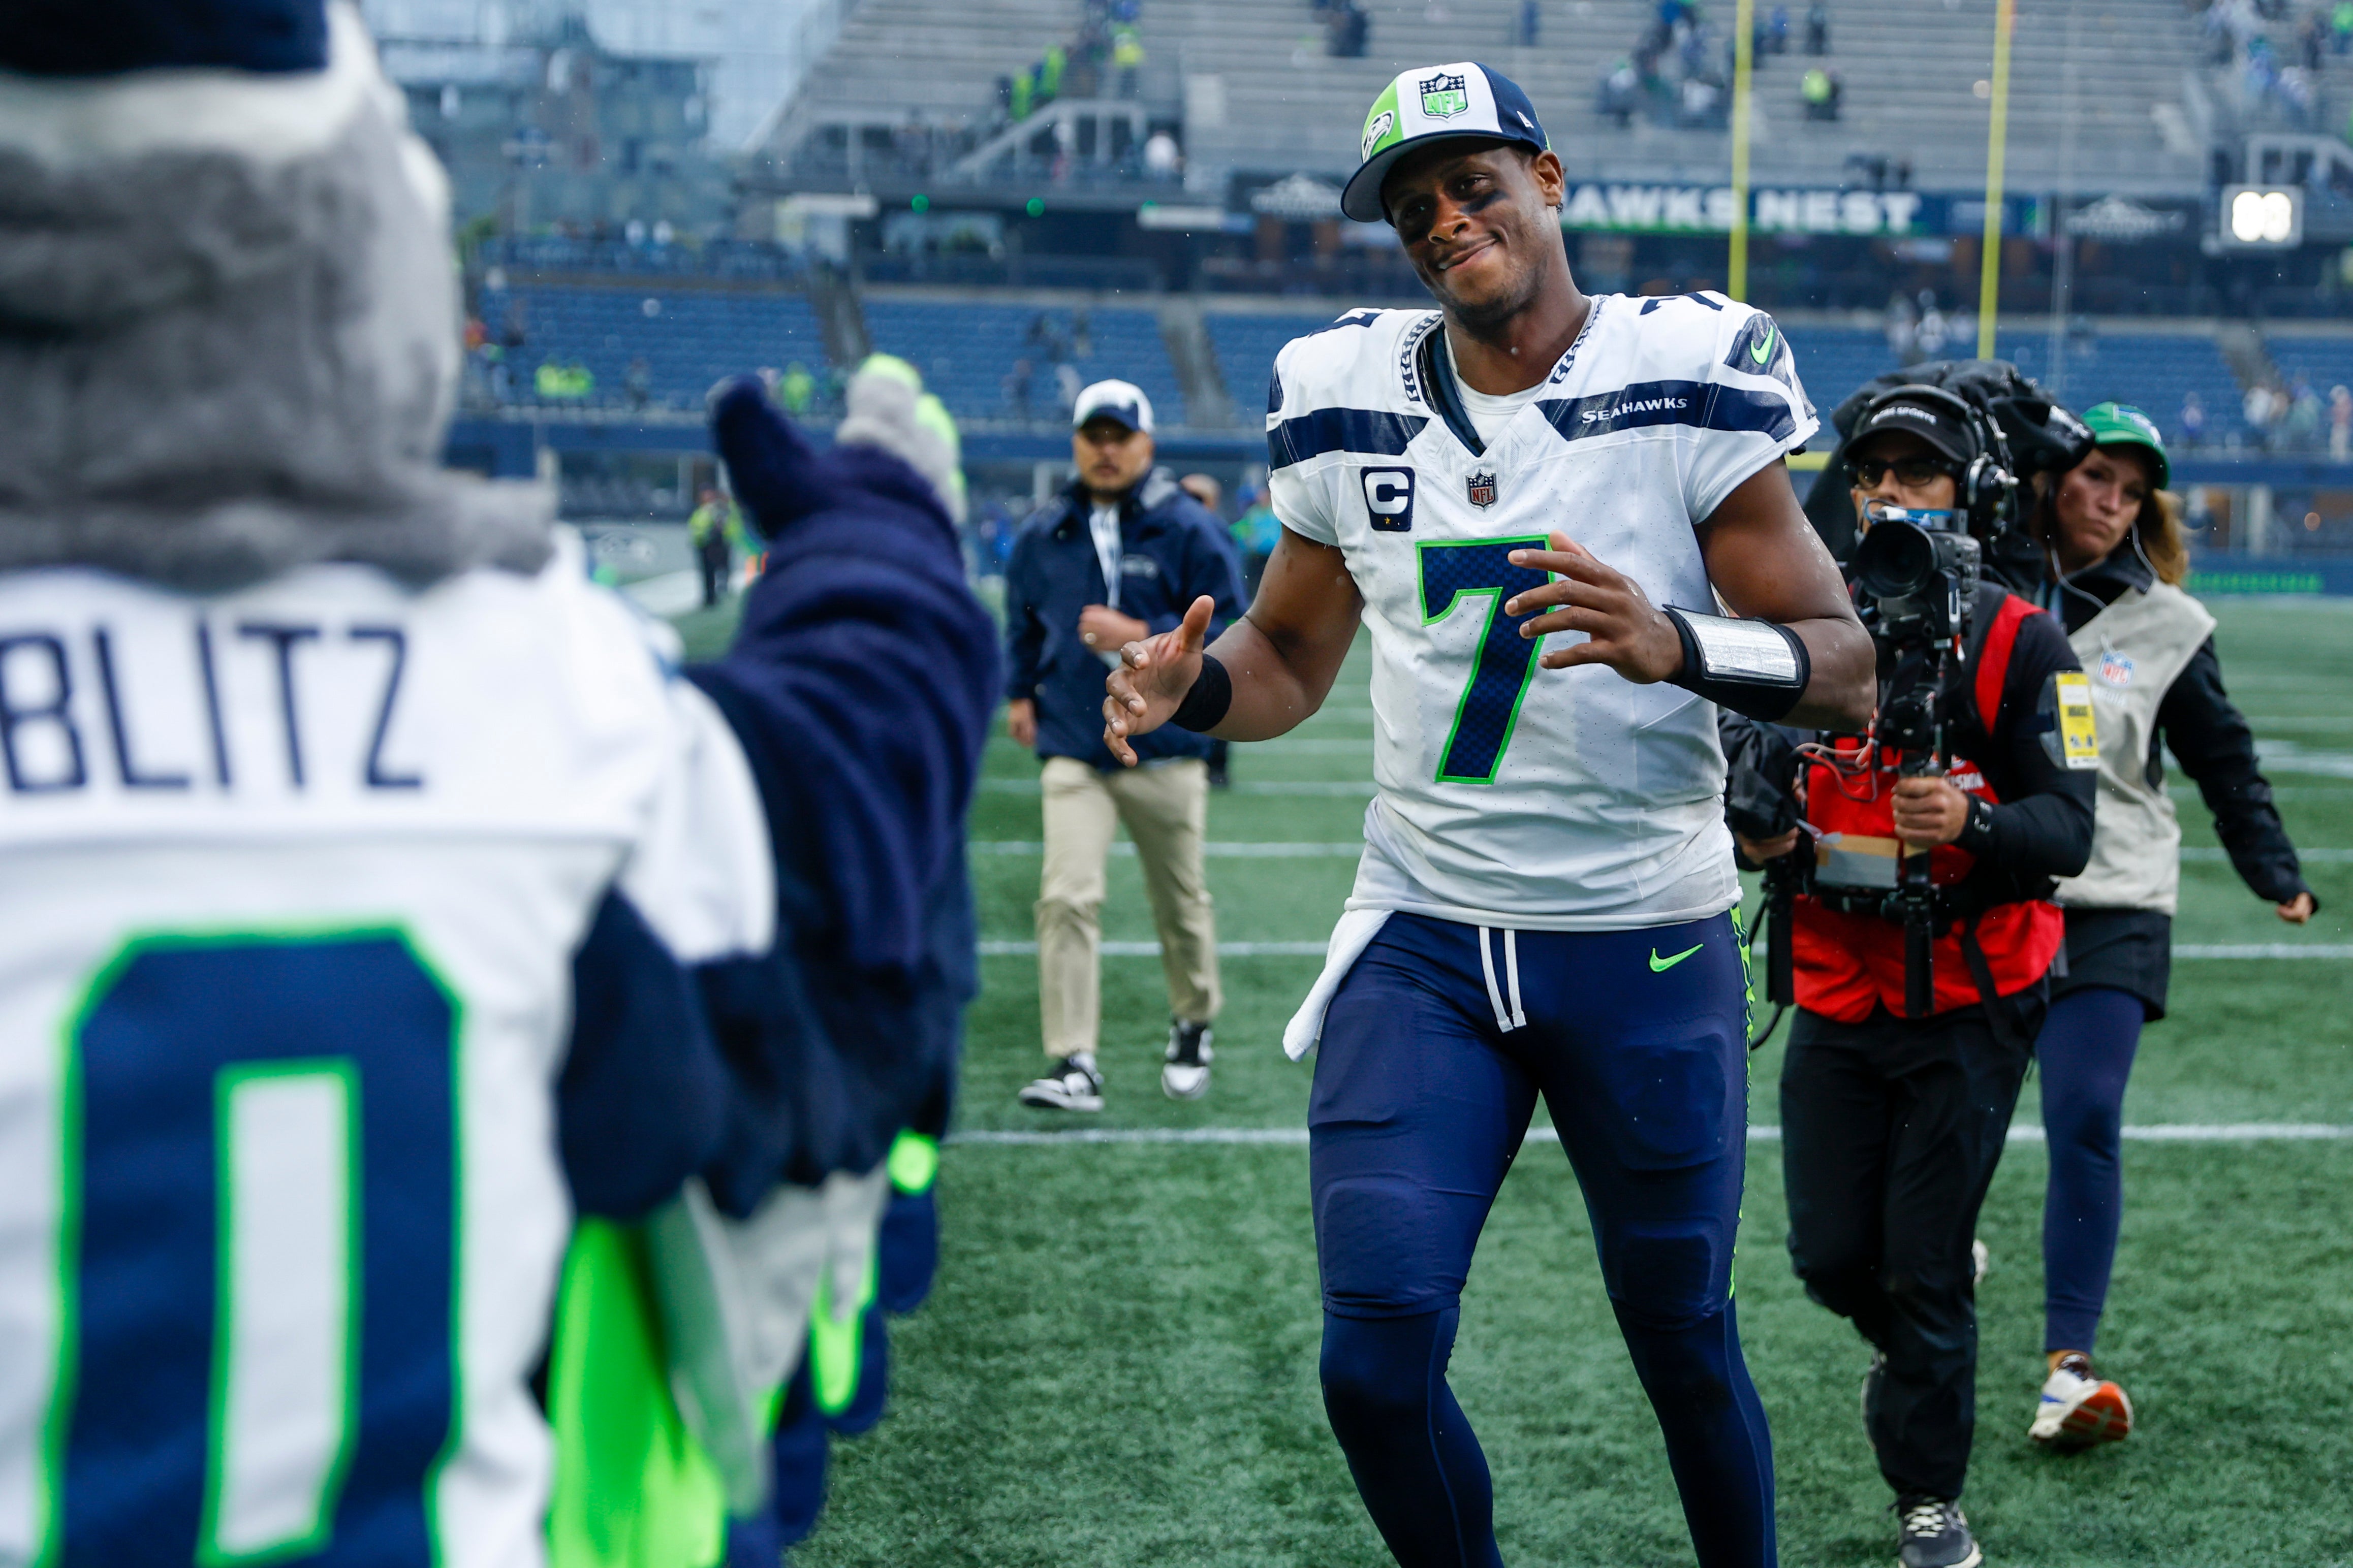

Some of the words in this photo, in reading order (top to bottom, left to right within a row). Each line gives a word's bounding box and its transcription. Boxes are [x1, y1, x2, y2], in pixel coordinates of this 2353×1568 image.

[1423, 92, 1466, 114] NFL
[1563, 184, 1744, 228] AWKS
[1754, 189, 1922, 234] NEST
[1582, 397, 1688, 424] SEAHAWKS
[1365, 471, 1409, 514] C
[1471, 487, 1494, 503] NFL
[1416, 534, 1556, 784] 7
[0, 620, 426, 794] BLITZ
